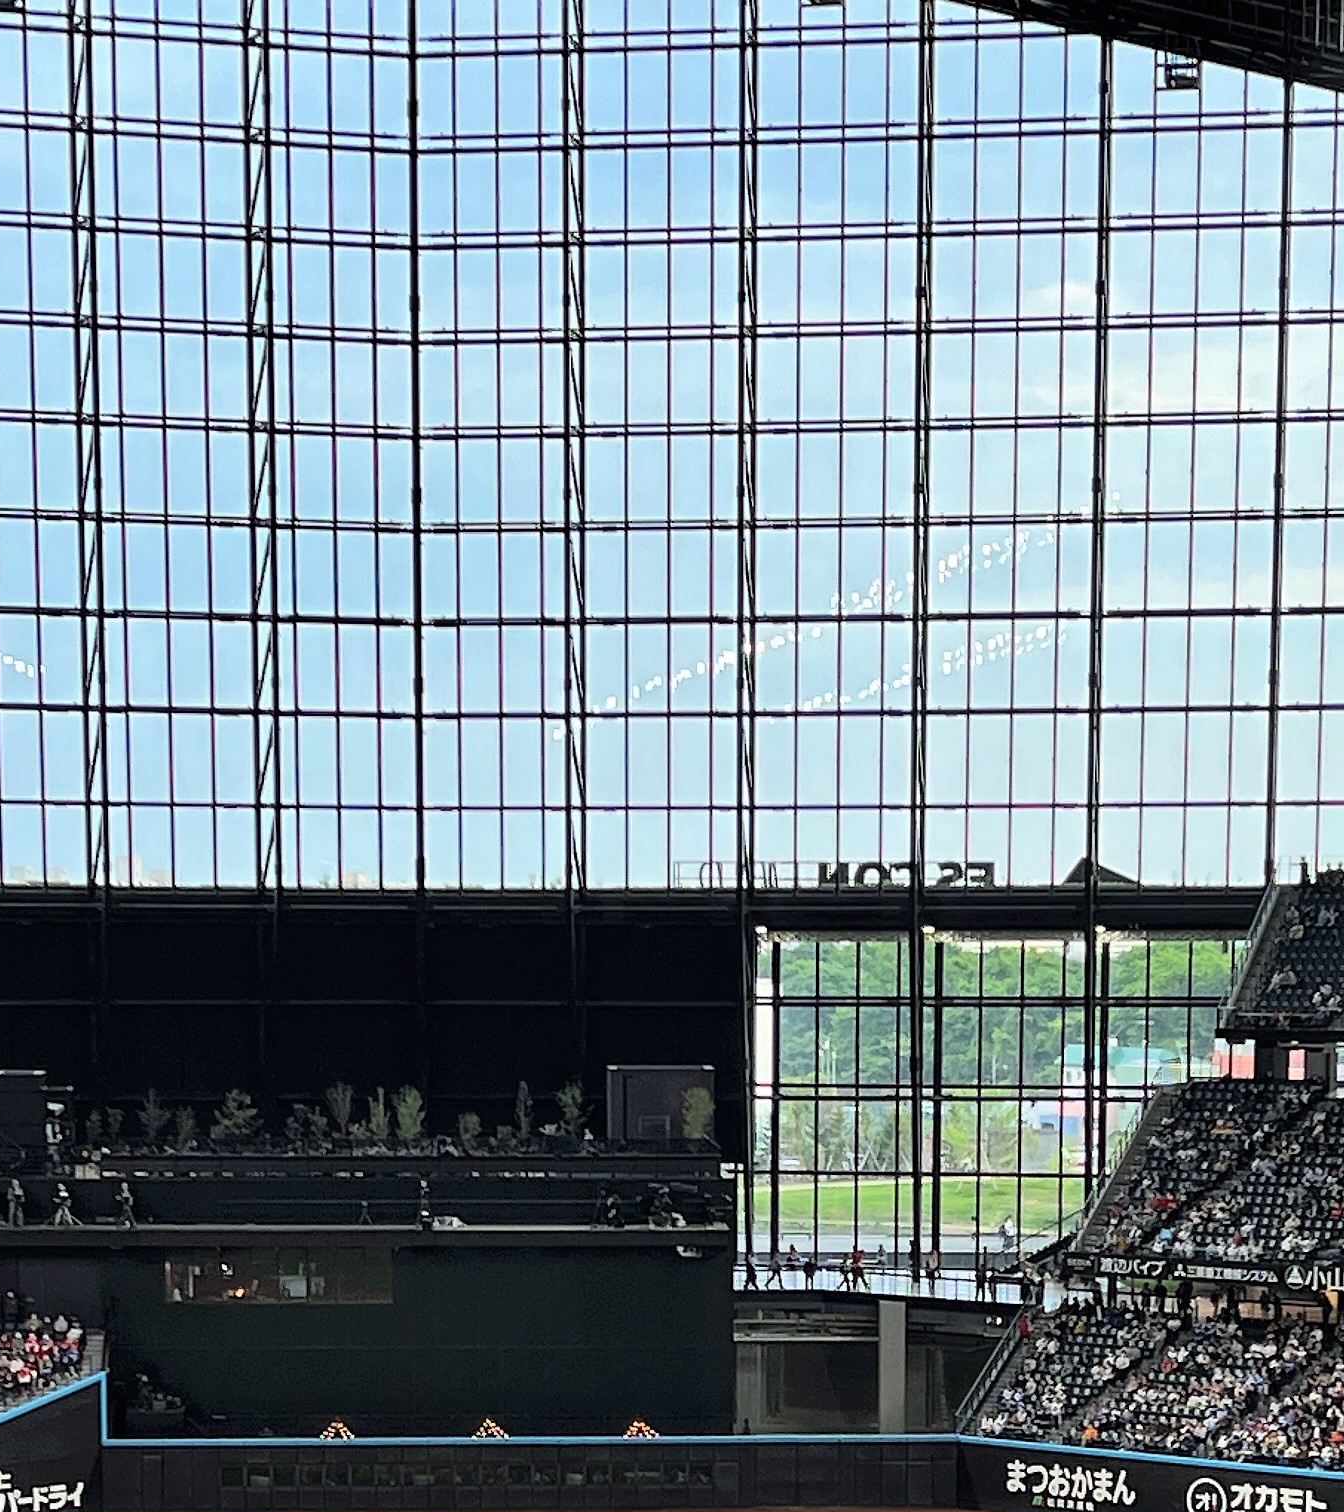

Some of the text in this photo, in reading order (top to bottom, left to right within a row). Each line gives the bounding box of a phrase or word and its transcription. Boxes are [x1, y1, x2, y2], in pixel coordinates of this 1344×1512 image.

[1006, 1458, 1136, 1505] まつおかまん
